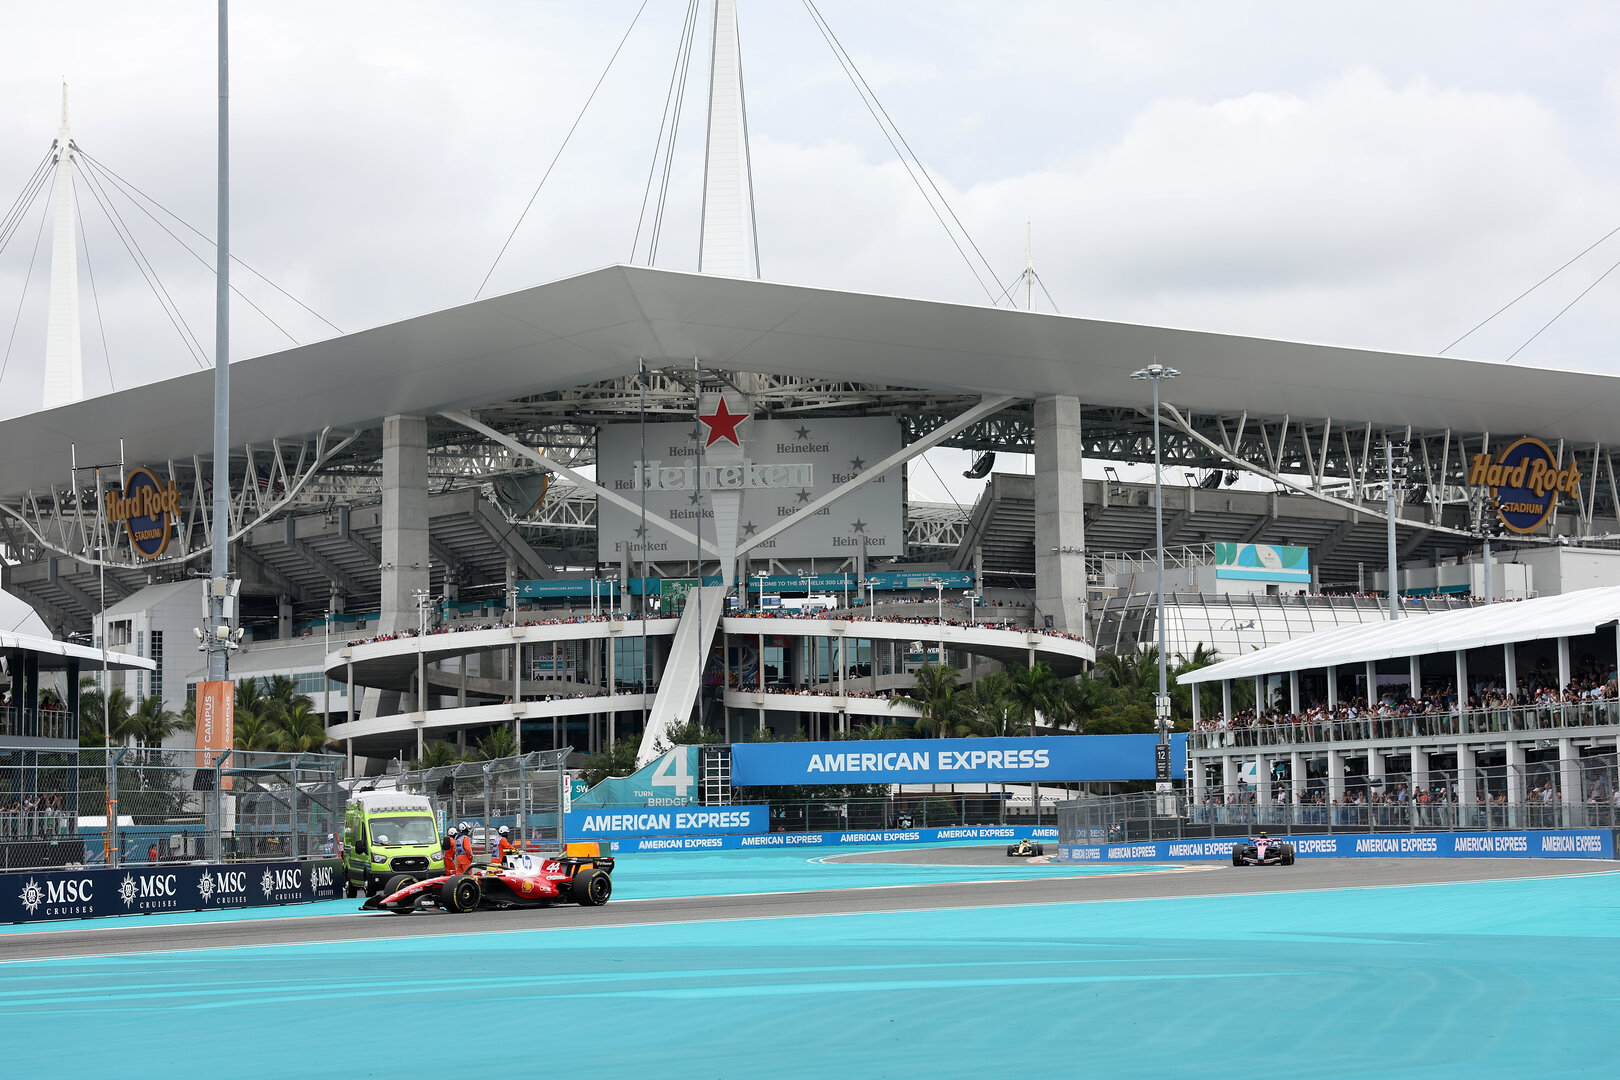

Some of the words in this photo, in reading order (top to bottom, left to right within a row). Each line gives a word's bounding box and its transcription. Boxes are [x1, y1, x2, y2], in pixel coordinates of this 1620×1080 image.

[669, 446, 706, 457] Heinek
[776, 443, 829, 454] Heineken
[633, 459, 812, 491] Heineken
[1468, 453, 1529, 488] Hard
[1526, 458, 1581, 500] Rock
[105, 485, 143, 522] Hard
[142, 480, 182, 522] Rock
[669, 508, 714, 520] Heinke
[777, 506, 830, 517] Heien
[1503, 502, 1543, 514] STADIUM
[134, 528, 162, 541] STADIUM
[615, 541, 668, 553] Hineken
[832, 536, 886, 547] Heinken
[806, 752, 930, 772] AMERICAN
[938, 749, 1050, 770] EXPRESS
[1157, 751, 1166, 760] 12
[652, 746, 694, 796] 4
[648, 798, 688, 806] BRIDGE
[582, 813, 670, 832] AMERICAN
[676, 812, 750, 829] EXPRESS
[840, 833, 884, 842] AMERICAN
[884, 832, 920, 842] EXPRESS
[938, 830, 978, 839] AMERICAN
[979, 829, 1015, 838] EXPRESS
[1032, 829, 1059, 838] AMERI
[638, 840, 682, 850] AMERICAN
[684, 838, 723, 848] EXPRESS
[741, 836, 784, 846] AMERICAN
[786, 834, 823, 844] EXPRESS
[1298, 840, 1337, 852] EXPRESS
[1356, 839, 1400, 852] AMERICAN
[1400, 838, 1438, 852] EXPRESS
[1454, 838, 1494, 852] AMERICAN
[1495, 836, 1528, 851] EXPRESS
[1542, 836, 1575, 852] AMERICAN
[1576, 836, 1602, 852] EXPRESS
[1108, 846, 1131, 859] AMERICAN
[1132, 846, 1156, 858] EXPRESS
[1168, 844, 1204, 856] AMERICAN
[546, 862, 560, 873] 44
[275, 869, 302, 890] MSC
[318, 866, 333, 886] MSC
[140, 874, 176, 898] MSC
[216, 872, 246, 894] MSC
[46, 880, 93, 904] MSC
[275, 892, 302, 900] CRUISES
[140, 900, 177, 908] CRUISES
[216, 896, 247, 904] CRUISES
[46, 906, 94, 916] CRUISES
